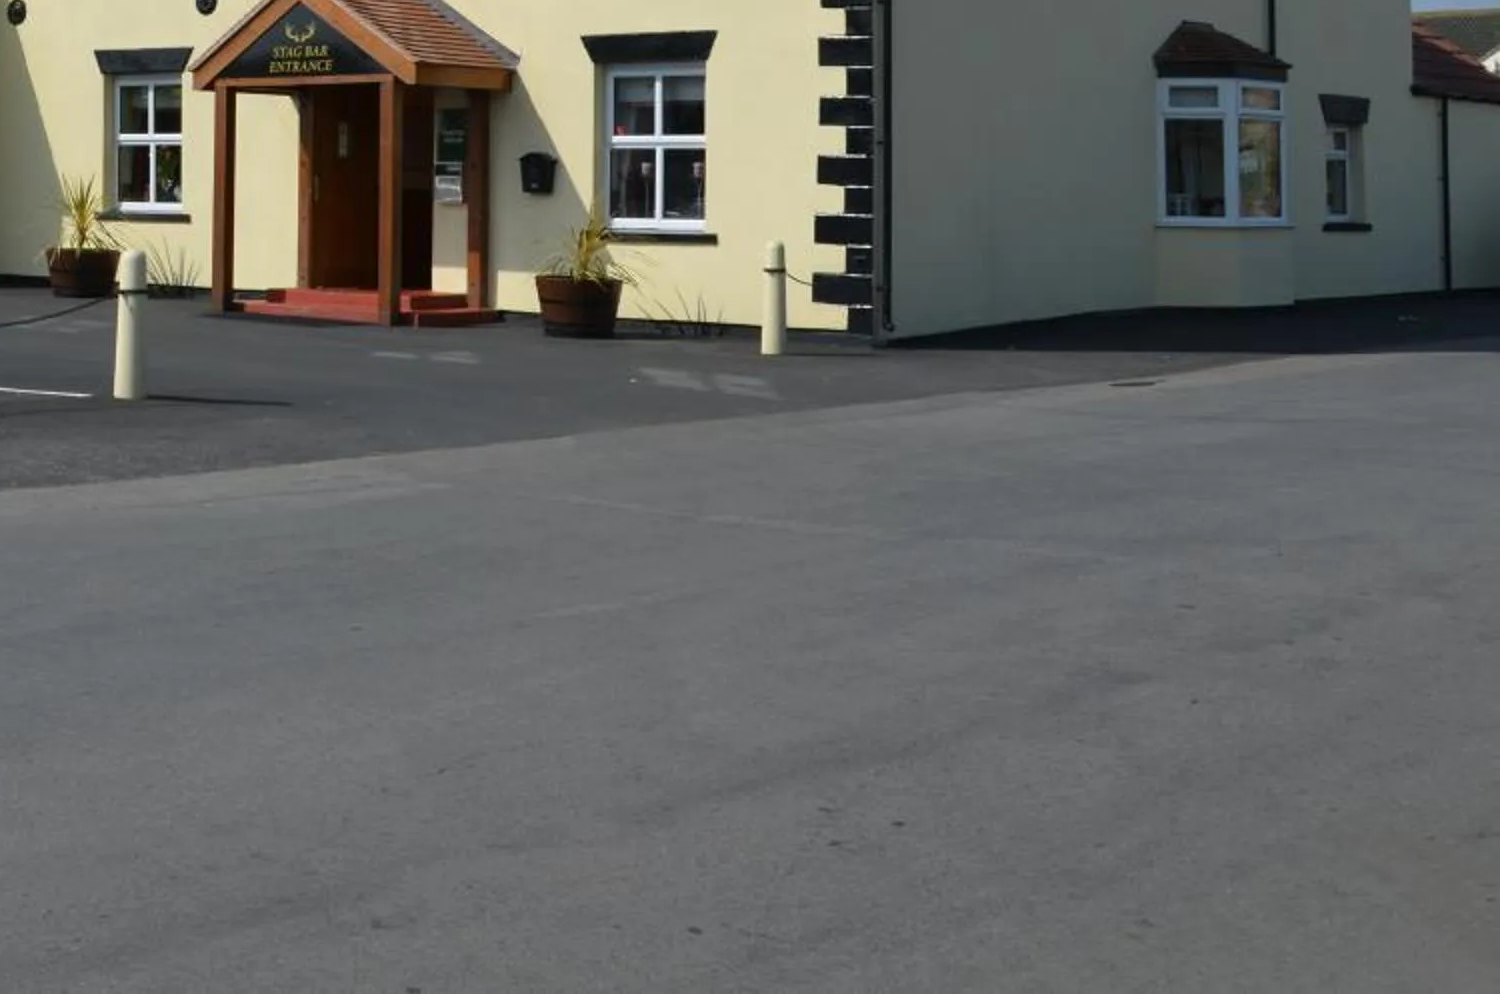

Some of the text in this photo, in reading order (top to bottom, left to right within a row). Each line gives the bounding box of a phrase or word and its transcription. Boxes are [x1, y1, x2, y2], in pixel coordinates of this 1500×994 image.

[272, 45, 329, 59] STAG BAR
[269, 59, 333, 73] ENTRANCE
